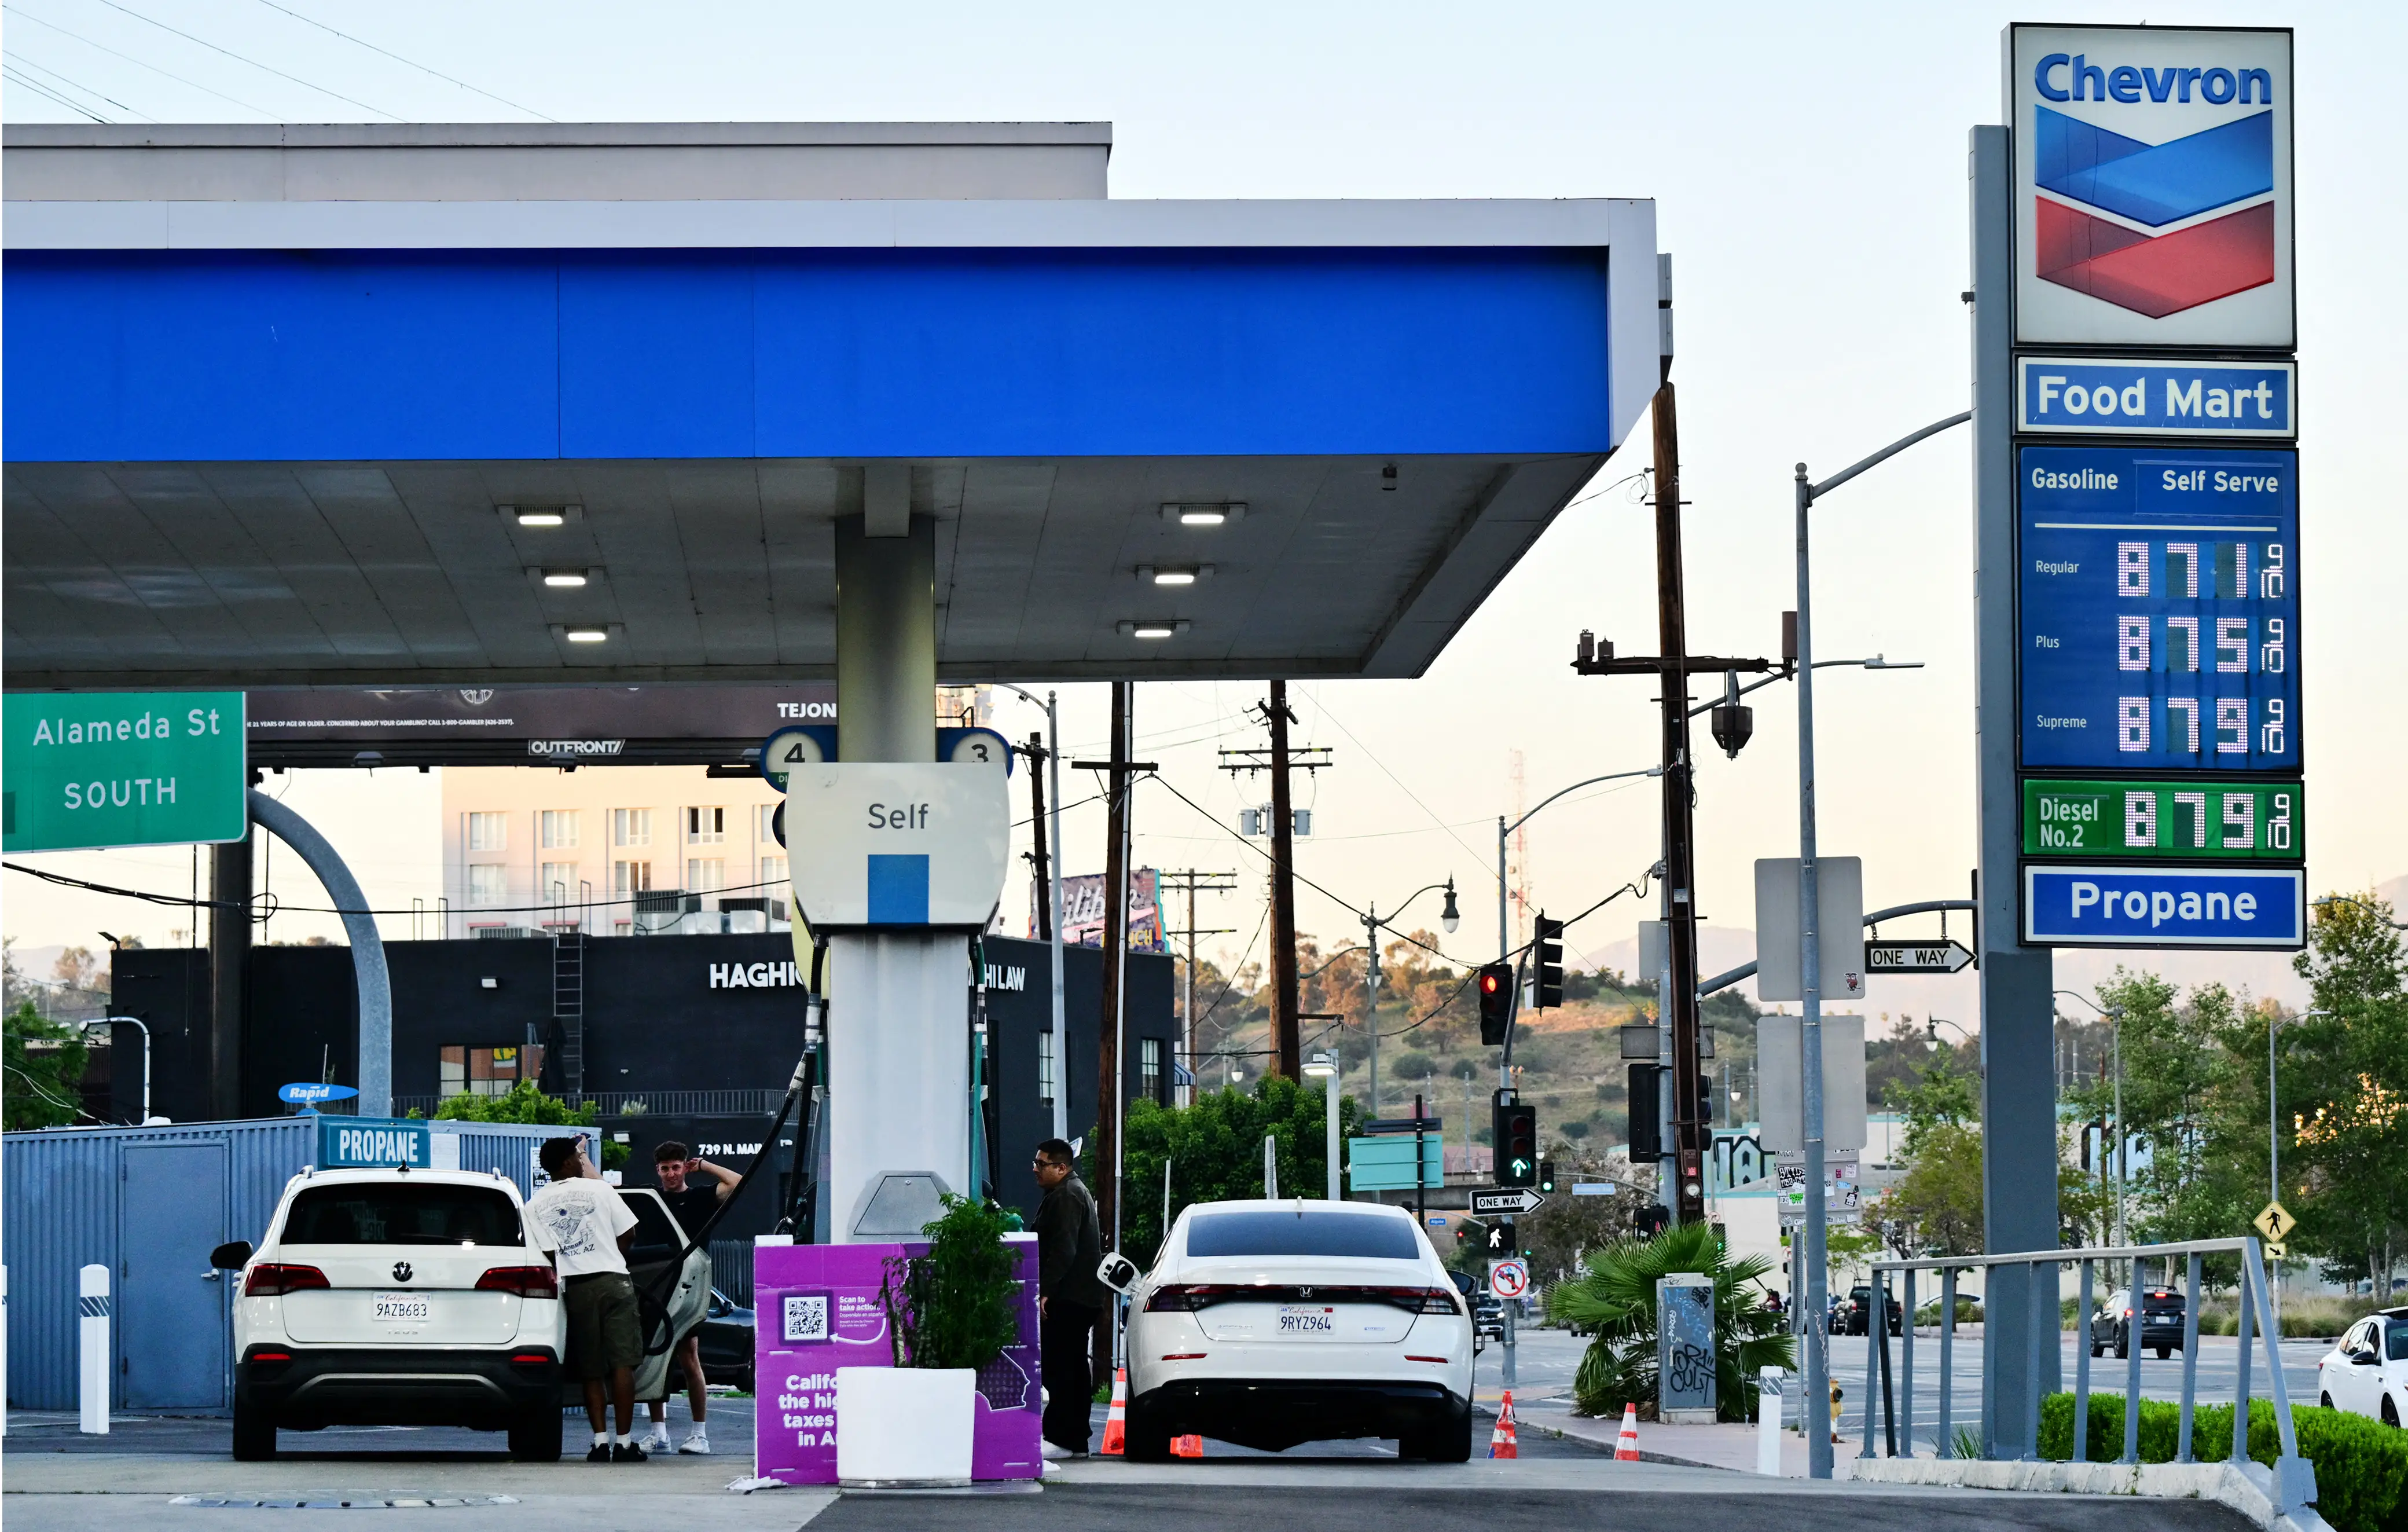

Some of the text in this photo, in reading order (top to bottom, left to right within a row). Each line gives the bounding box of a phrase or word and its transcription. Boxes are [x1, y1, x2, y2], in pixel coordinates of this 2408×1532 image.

[2034, 53, 2273, 105] Chevron
[2038, 376, 2273, 420] Food Mart
[2031, 467, 2279, 493] Gasoline Self Serve
[2036, 560, 2080, 574] Regular
[2036, 635, 2060, 648] Plus
[777, 702, 837, 718] TEJON
[32, 708, 221, 746] Alameda St
[2036, 714, 2087, 731] Supreme
[784, 743, 806, 764] 4
[868, 803, 930, 830] Self
[2040, 797, 2098, 822] Diesel
[2040, 824, 2084, 848] No.2
[2071, 882, 2258, 929] Propane
[1872, 950, 1948, 965] ONE WAY
[710, 961, 803, 989] HAGHI
[997, 965, 1026, 991] LAW
[289, 1086, 330, 1100] Rapid
[339, 1129, 419, 1163] PROPANE
[698, 1143, 721, 1155] 739
[723, 1143, 735, 1155] N.
[1479, 1196, 1523, 1208] ONE WAY
[563, 1238, 584, 1251] Annual
[583, 1243, 596, 1254] AZ
[377, 1303, 427, 1317] 9AZB683
[1289, 1306, 1322, 1315] California
[1280, 1315, 1331, 1330] 9RYZ964
[779, 1393, 810, 1409] the
[784, 1413, 835, 1428] taxes
[798, 1431, 816, 1446] in
